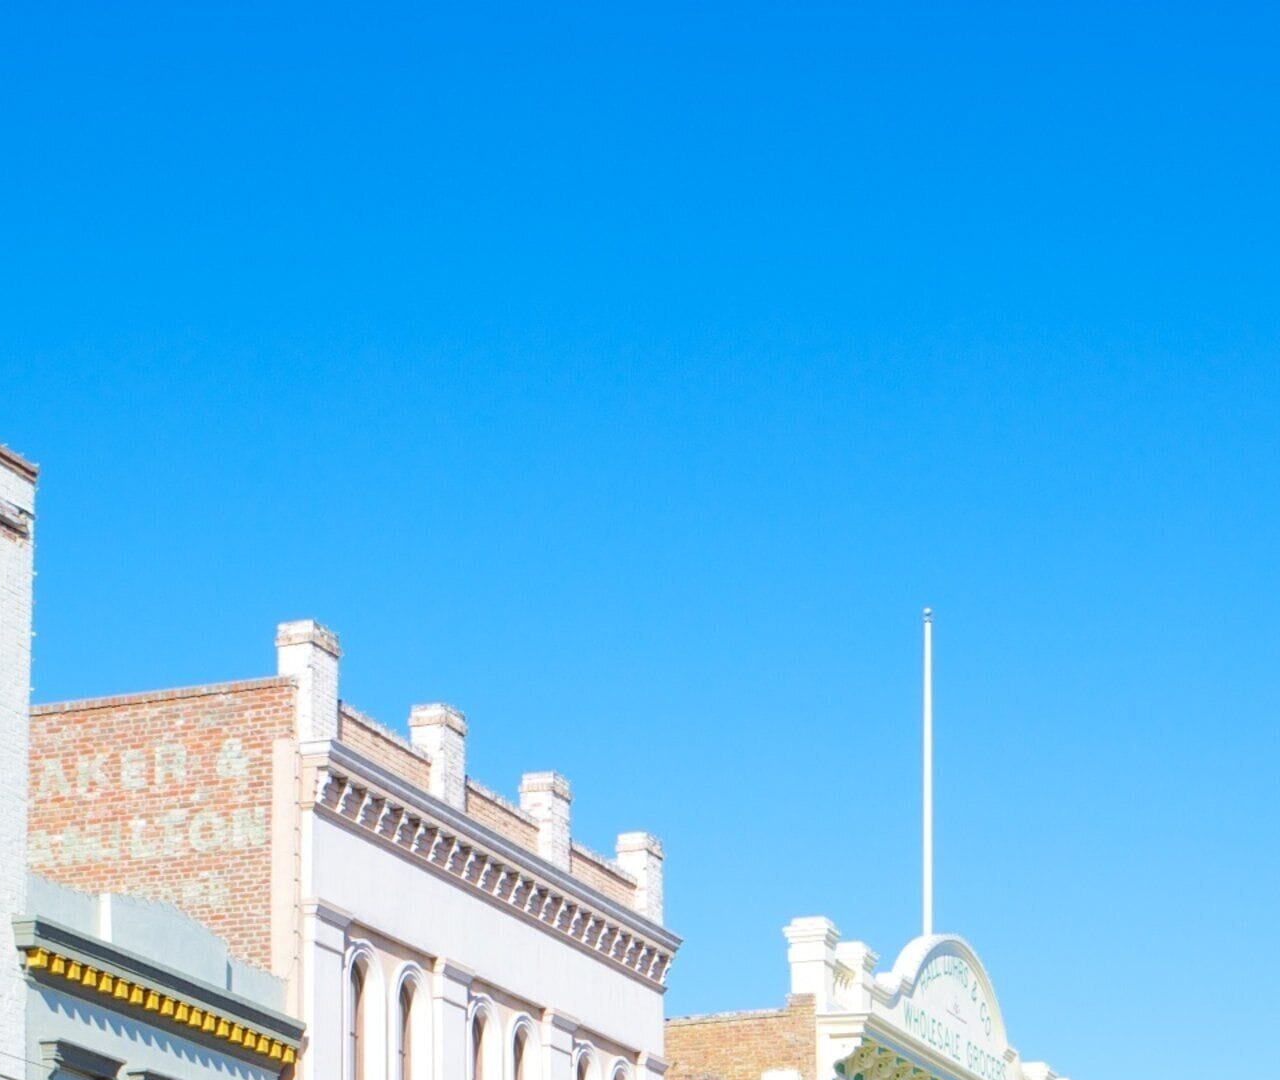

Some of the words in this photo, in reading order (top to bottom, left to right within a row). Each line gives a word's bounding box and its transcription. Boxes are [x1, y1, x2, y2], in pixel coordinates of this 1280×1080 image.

[38, 744, 186, 798] AKER
[216, 738, 250, 778] &
[903, 1000, 961, 1062] WHOLESALE
